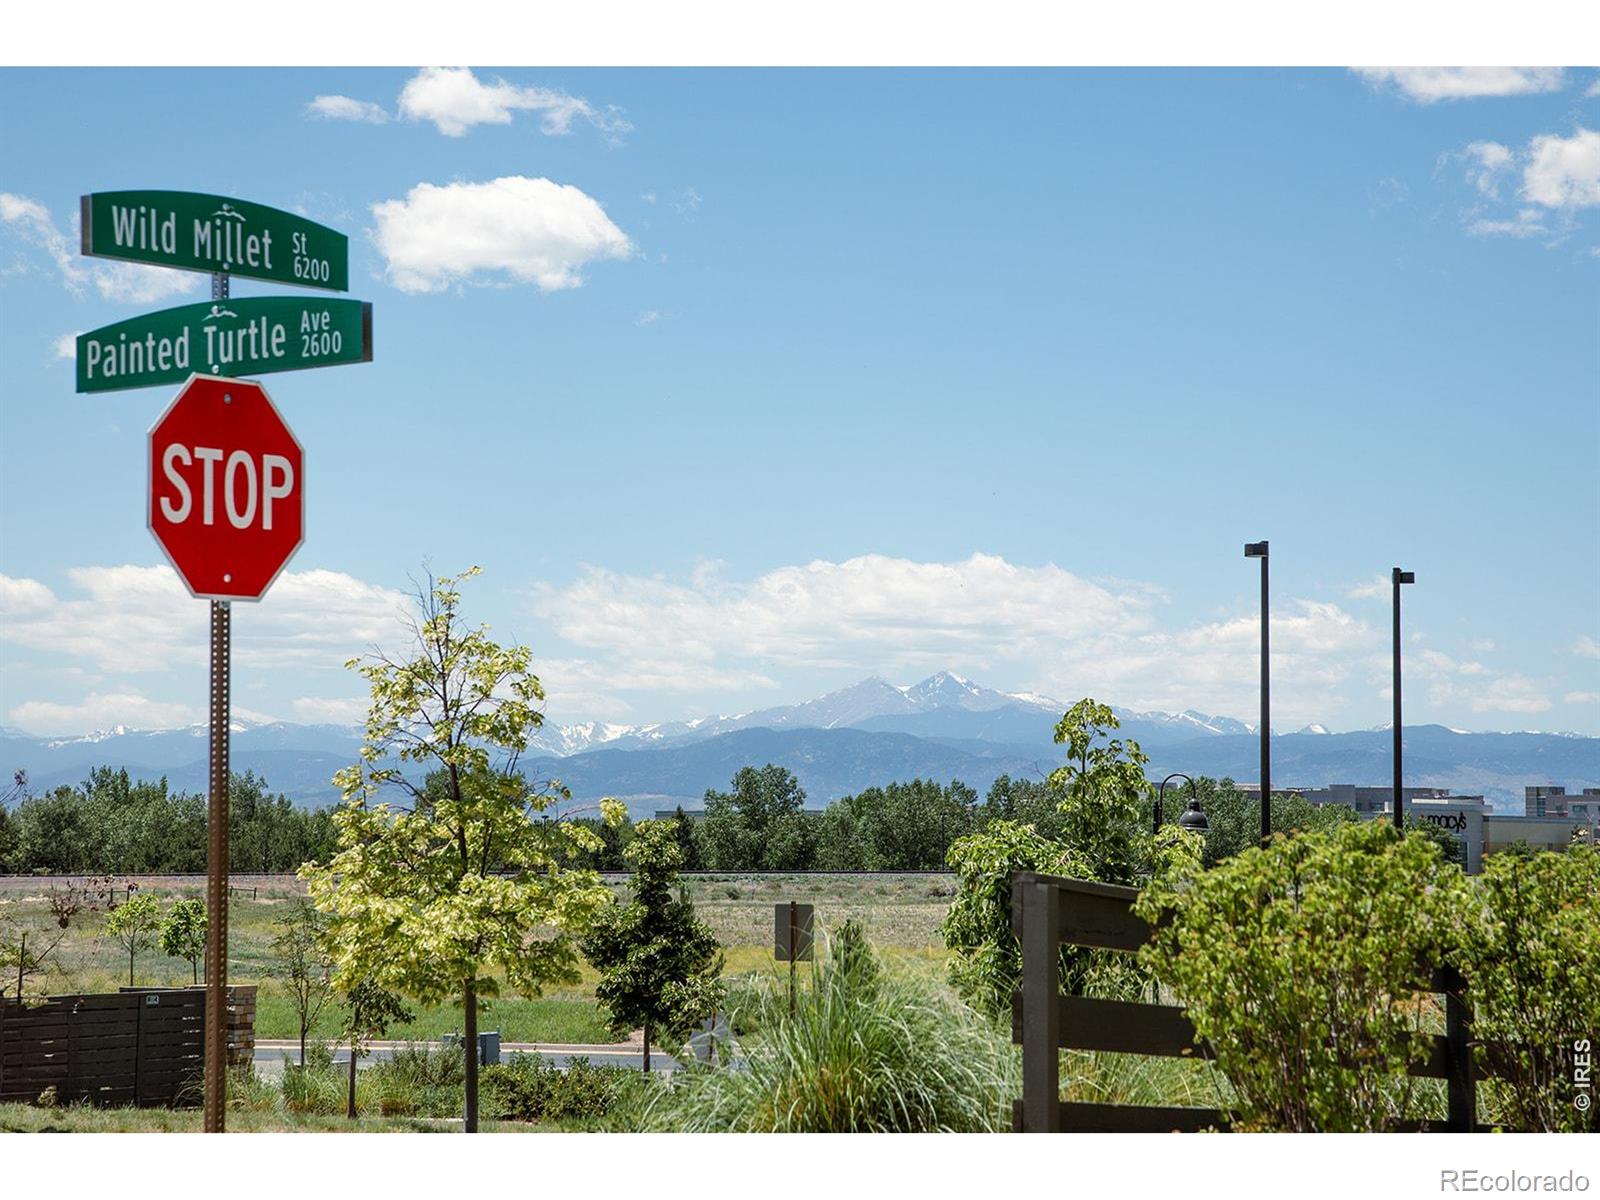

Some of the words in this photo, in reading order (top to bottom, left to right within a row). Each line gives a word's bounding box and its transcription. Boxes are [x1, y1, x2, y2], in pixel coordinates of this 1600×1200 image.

[112, 205, 176, 255] Wild
[193, 218, 272, 269] Millet
[292, 232, 307, 255] St
[294, 257, 330, 282] 6200
[300, 310, 330, 333] Ave
[87, 326, 189, 379] Painted
[203, 316, 286, 365] Turtle
[301, 332, 342, 357] 2600
[159, 442, 294, 530] STOP
